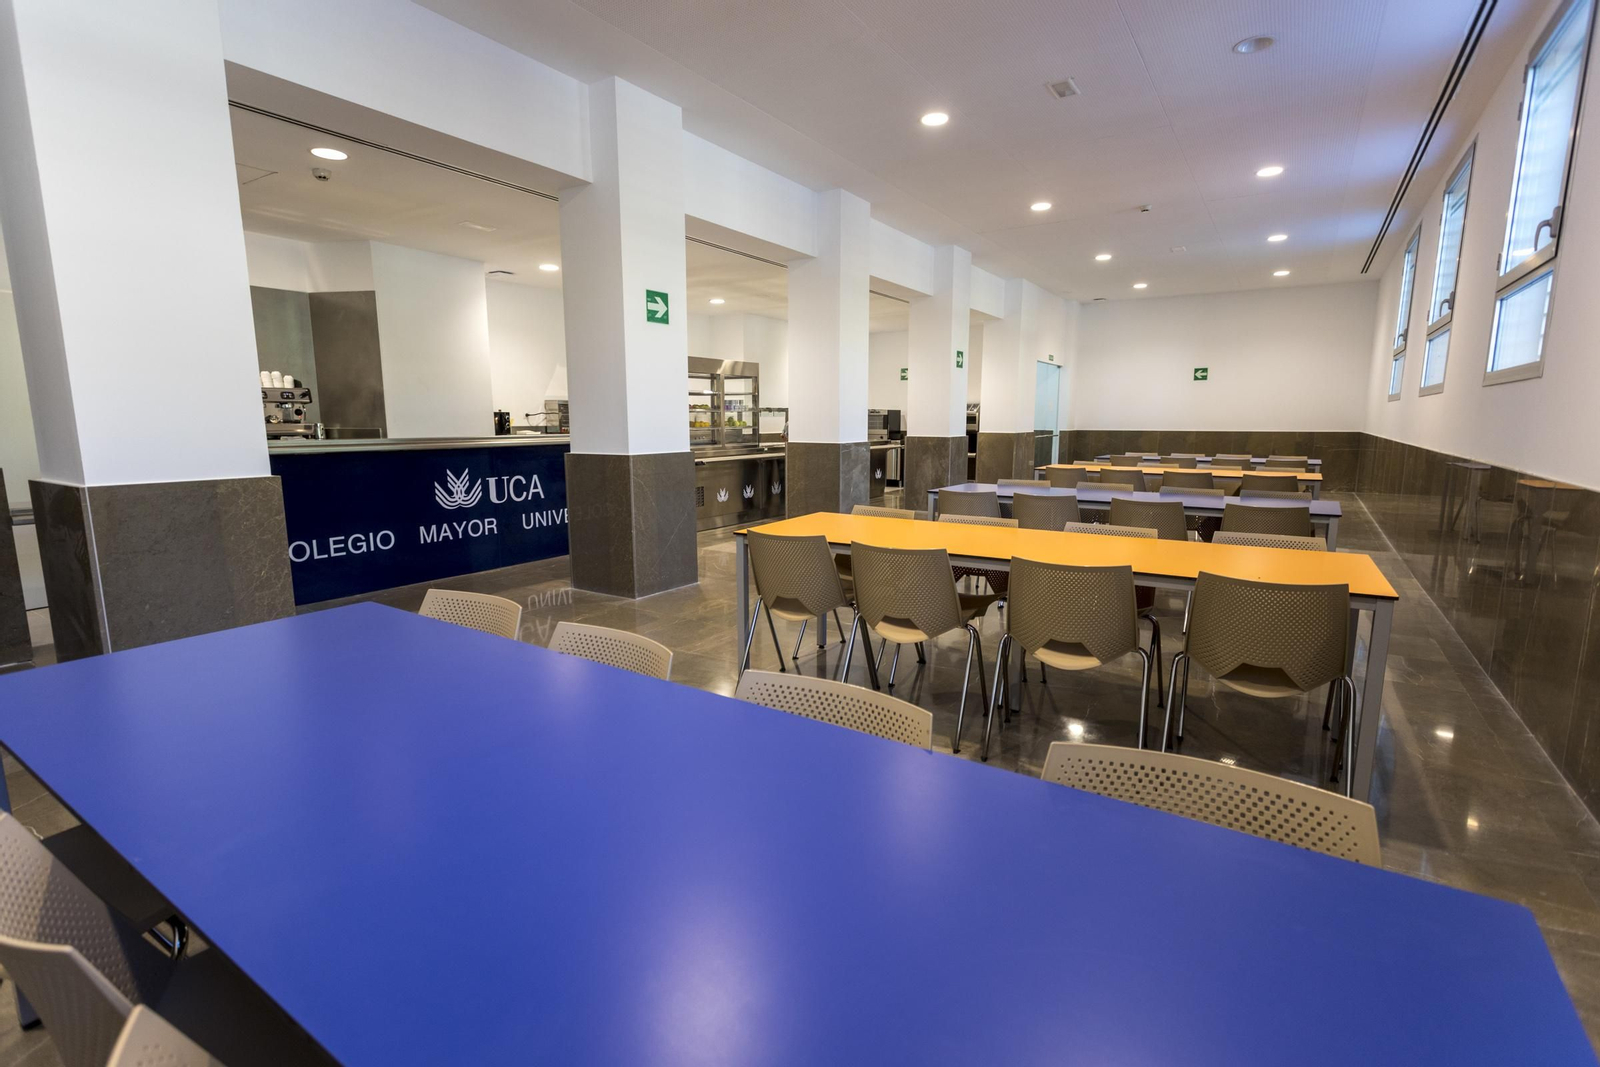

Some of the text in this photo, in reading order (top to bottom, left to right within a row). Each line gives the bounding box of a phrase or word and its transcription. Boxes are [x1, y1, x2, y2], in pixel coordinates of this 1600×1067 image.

[486, 474, 545, 504] UCA
[288, 530, 395, 562] OLEGIO
[419, 517, 498, 544] MAYOR
